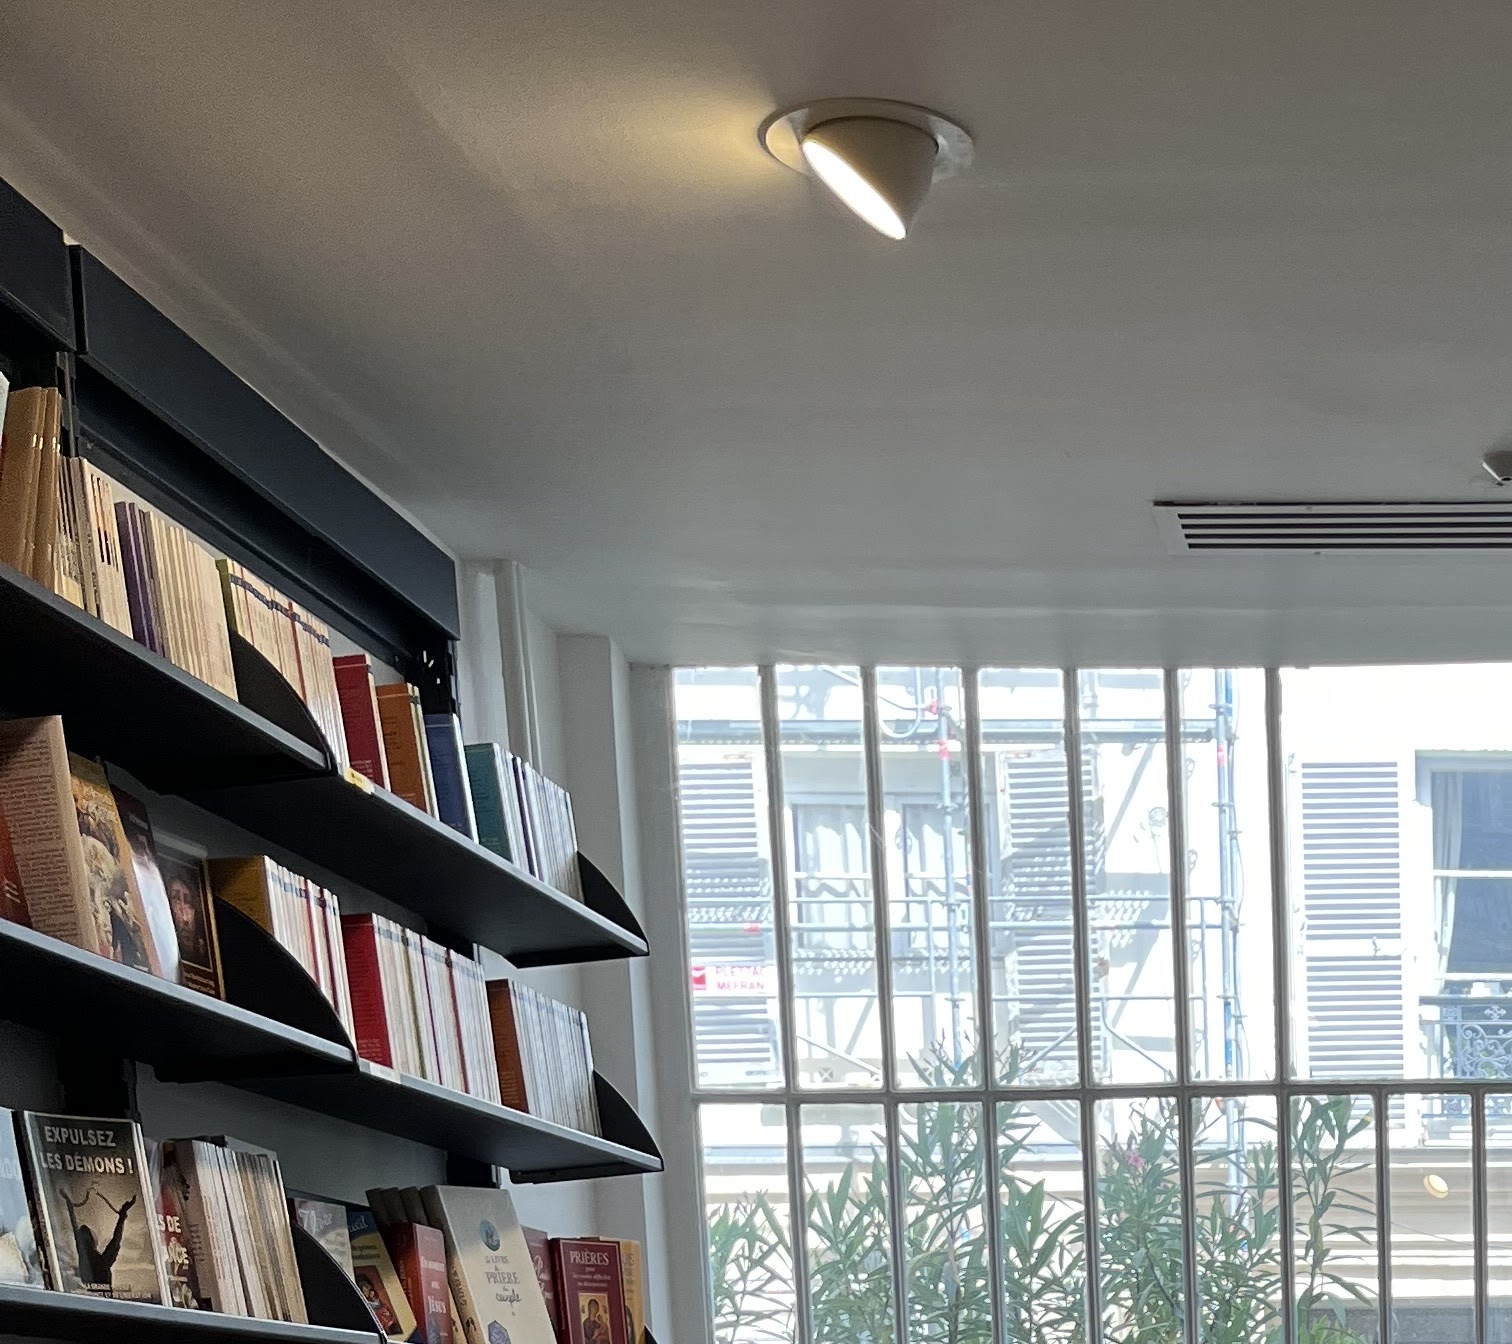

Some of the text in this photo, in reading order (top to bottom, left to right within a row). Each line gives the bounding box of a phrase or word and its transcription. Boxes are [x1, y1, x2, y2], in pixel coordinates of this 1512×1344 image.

[44, 1126, 116, 1147] EXPULSEZ
[41, 1152, 63, 1170] LES
[65, 1154, 125, 1174] DÉMONS
[569, 1248, 610, 1265] PRIÈRES
